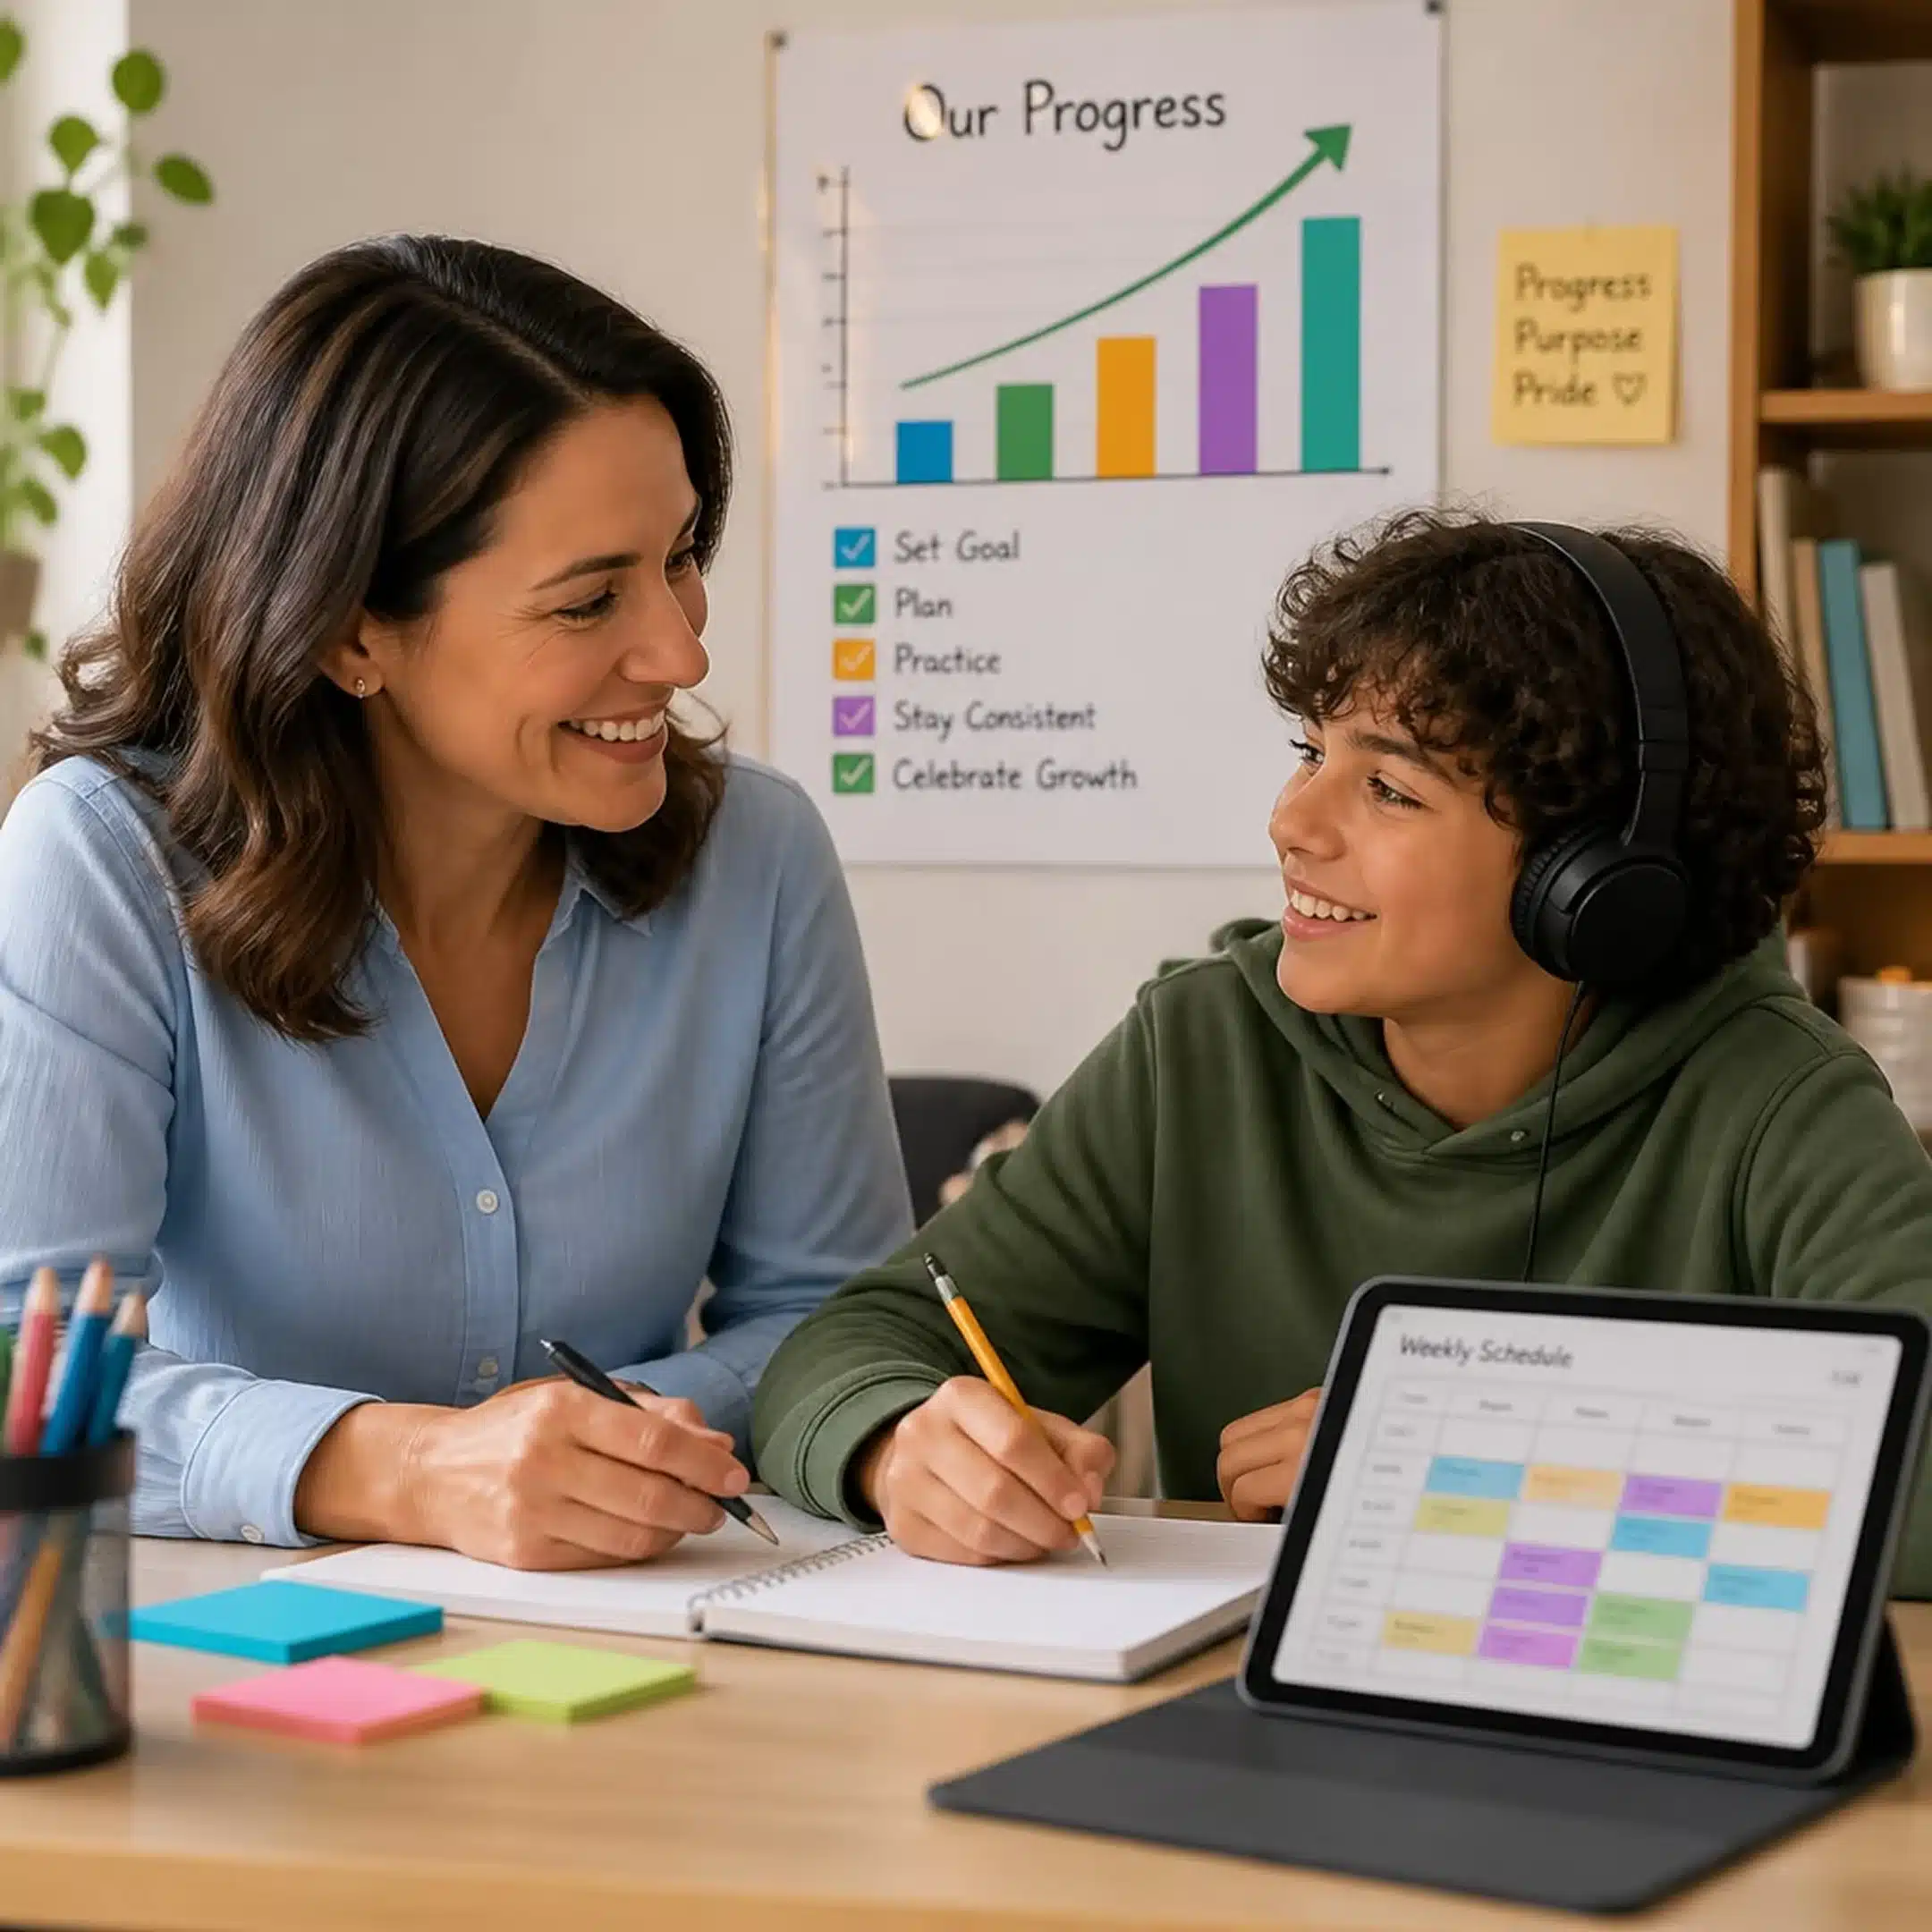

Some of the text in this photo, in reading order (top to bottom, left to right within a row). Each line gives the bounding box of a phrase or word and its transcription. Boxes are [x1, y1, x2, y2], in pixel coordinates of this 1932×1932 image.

[903, 78, 1226, 152] Our Progress
[1515, 260, 1652, 313] Progress
[1513, 317, 1643, 365] Purpose
[1513, 369, 1597, 407] Pride
[894, 530, 1021, 564] Set Goal
[894, 587, 953, 620] Plan
[894, 642, 1002, 675] Practice
[894, 699, 1096, 742] Stay Consistent
[892, 758, 1138, 792] Celebrate Growth
[1400, 1335, 1573, 1368] Weekly Schedule
